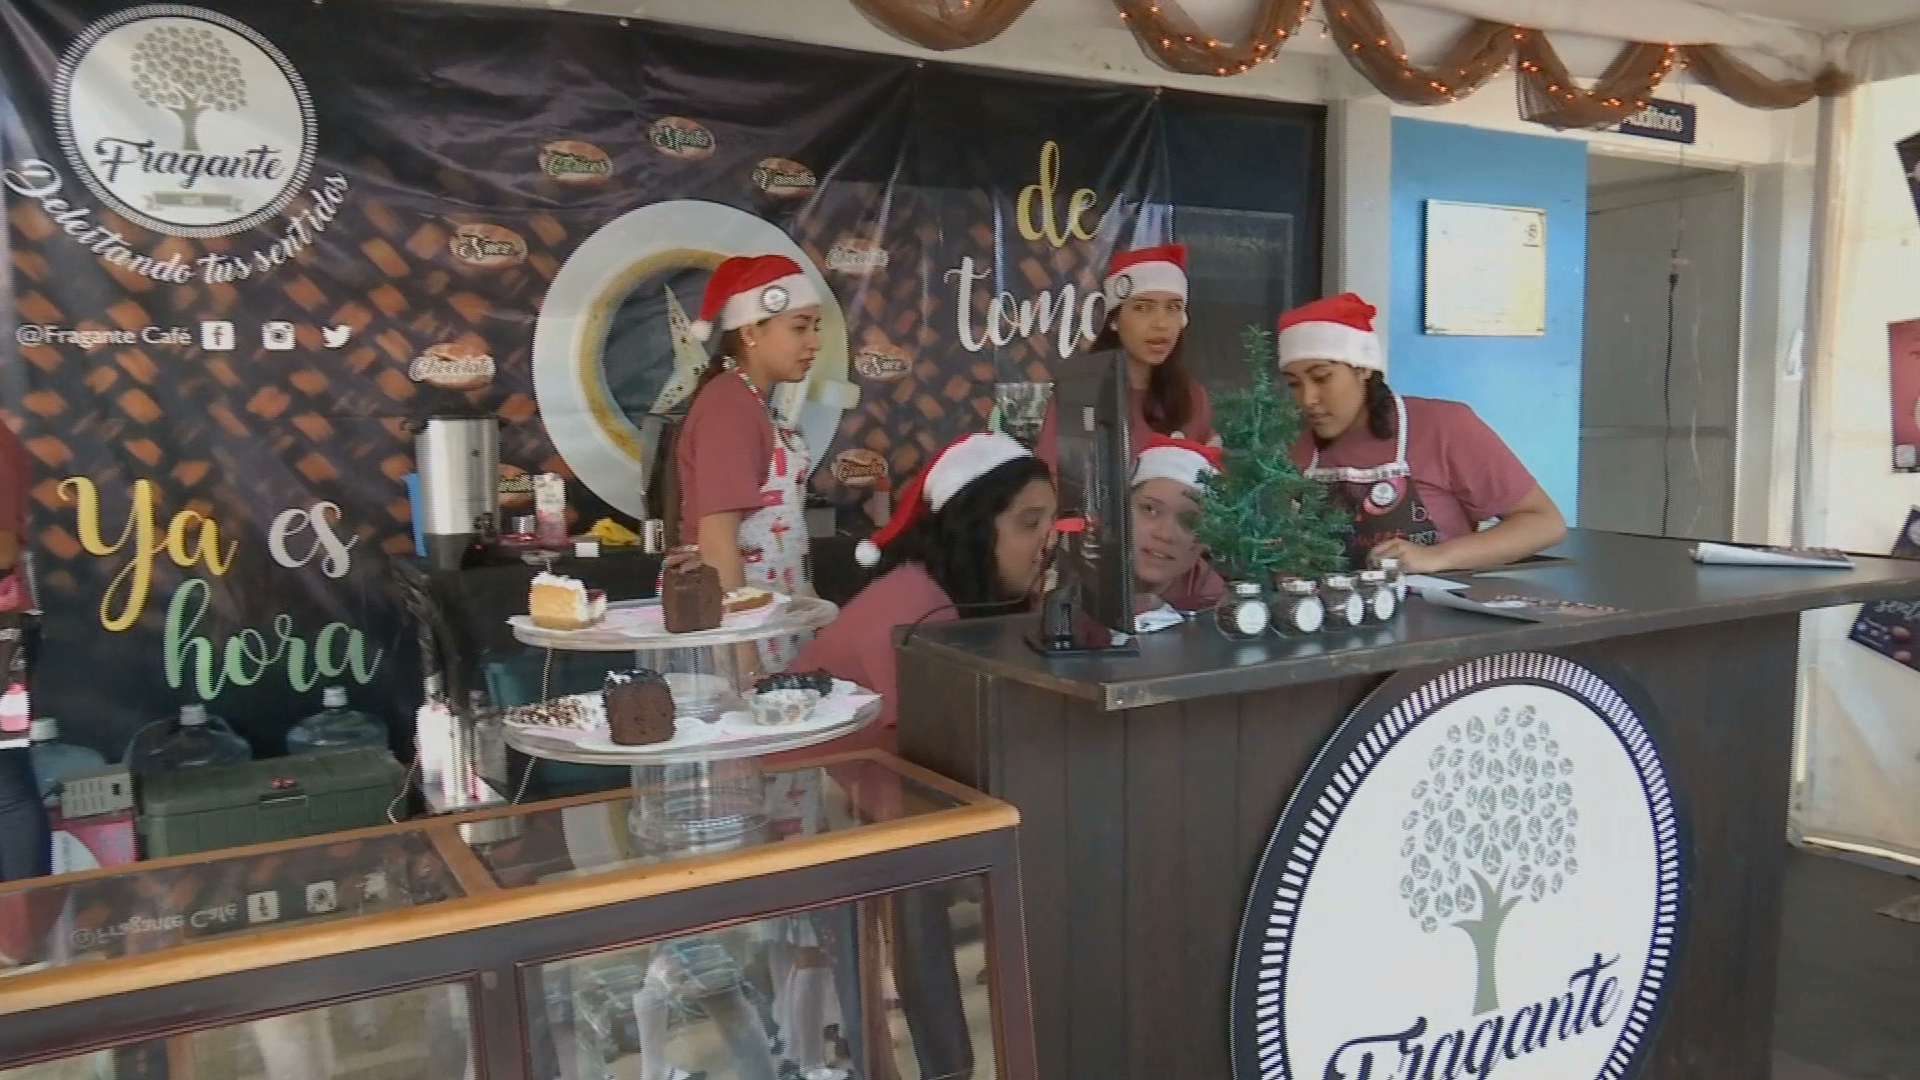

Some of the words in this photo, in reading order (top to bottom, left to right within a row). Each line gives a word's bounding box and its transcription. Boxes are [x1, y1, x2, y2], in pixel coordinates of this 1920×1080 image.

[94, 137, 285, 190] Fragante
[1016, 140, 1104, 248] de
[196, 252, 252, 285] tus
[253, 171, 349, 272] sentidos
[15, 324, 138, 350] @Fragante
[142, 324, 194, 346] Café
[57, 476, 238, 632] Ya
[267, 501, 359, 579] es
[164, 578, 384, 700] hora
